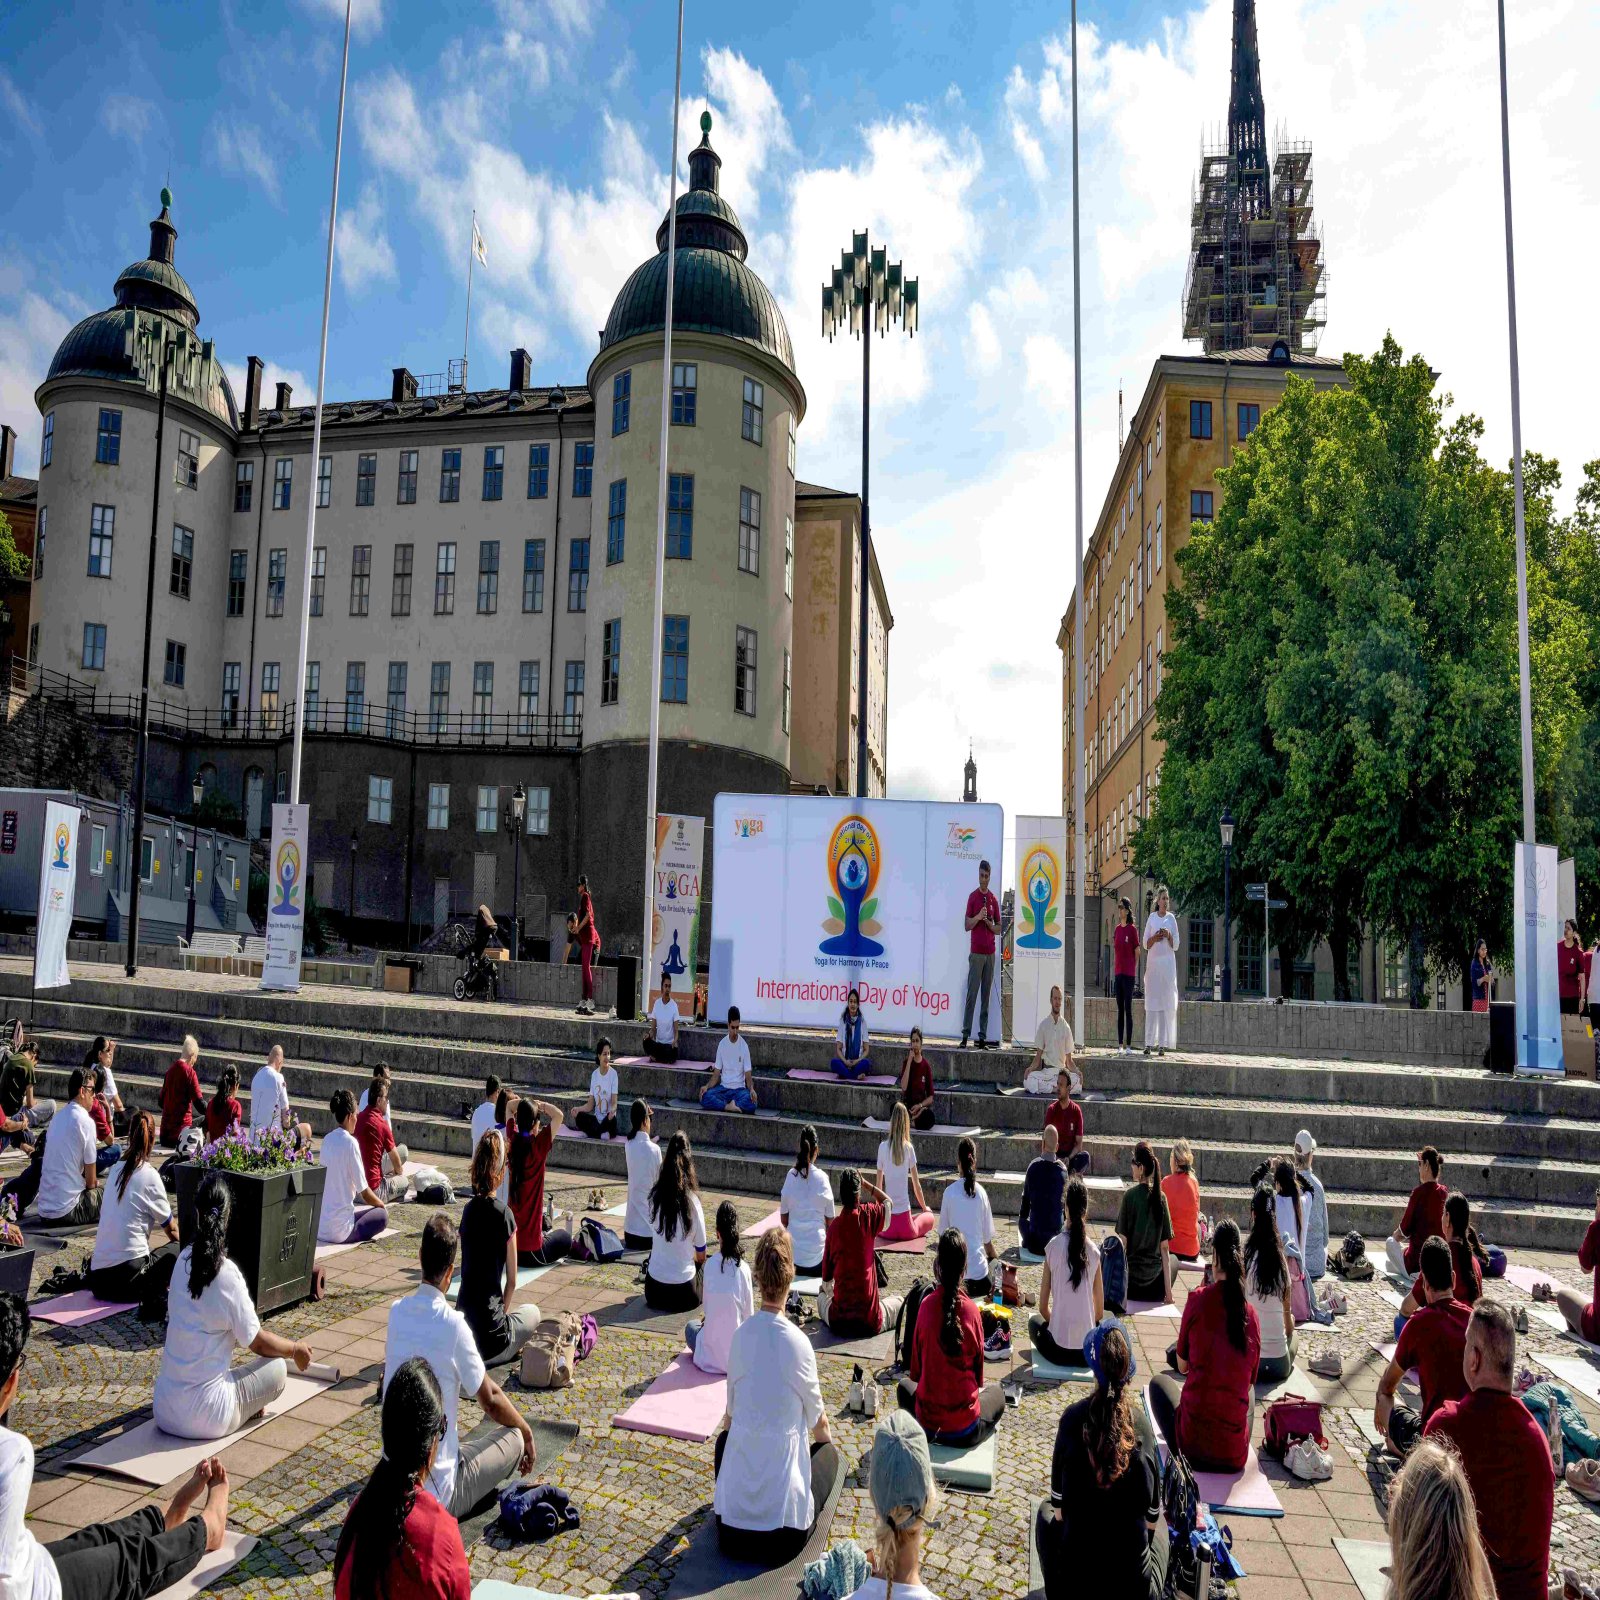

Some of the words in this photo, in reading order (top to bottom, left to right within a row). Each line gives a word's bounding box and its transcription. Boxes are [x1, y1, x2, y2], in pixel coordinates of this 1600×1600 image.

[734, 818, 763, 837] yoga
[657, 871, 700, 899] YOGA
[814, 956, 828, 967] Yoga
[829, 957, 837, 966] for
[839, 957, 865, 969] Harmony
[865, 959, 870, 967] &
[871, 959, 889, 969] Peace
[756, 976, 853, 1002] International
[858, 981, 887, 1011] Day
[892, 984, 909, 1007] of
[912, 985, 950, 1016] Yoga
